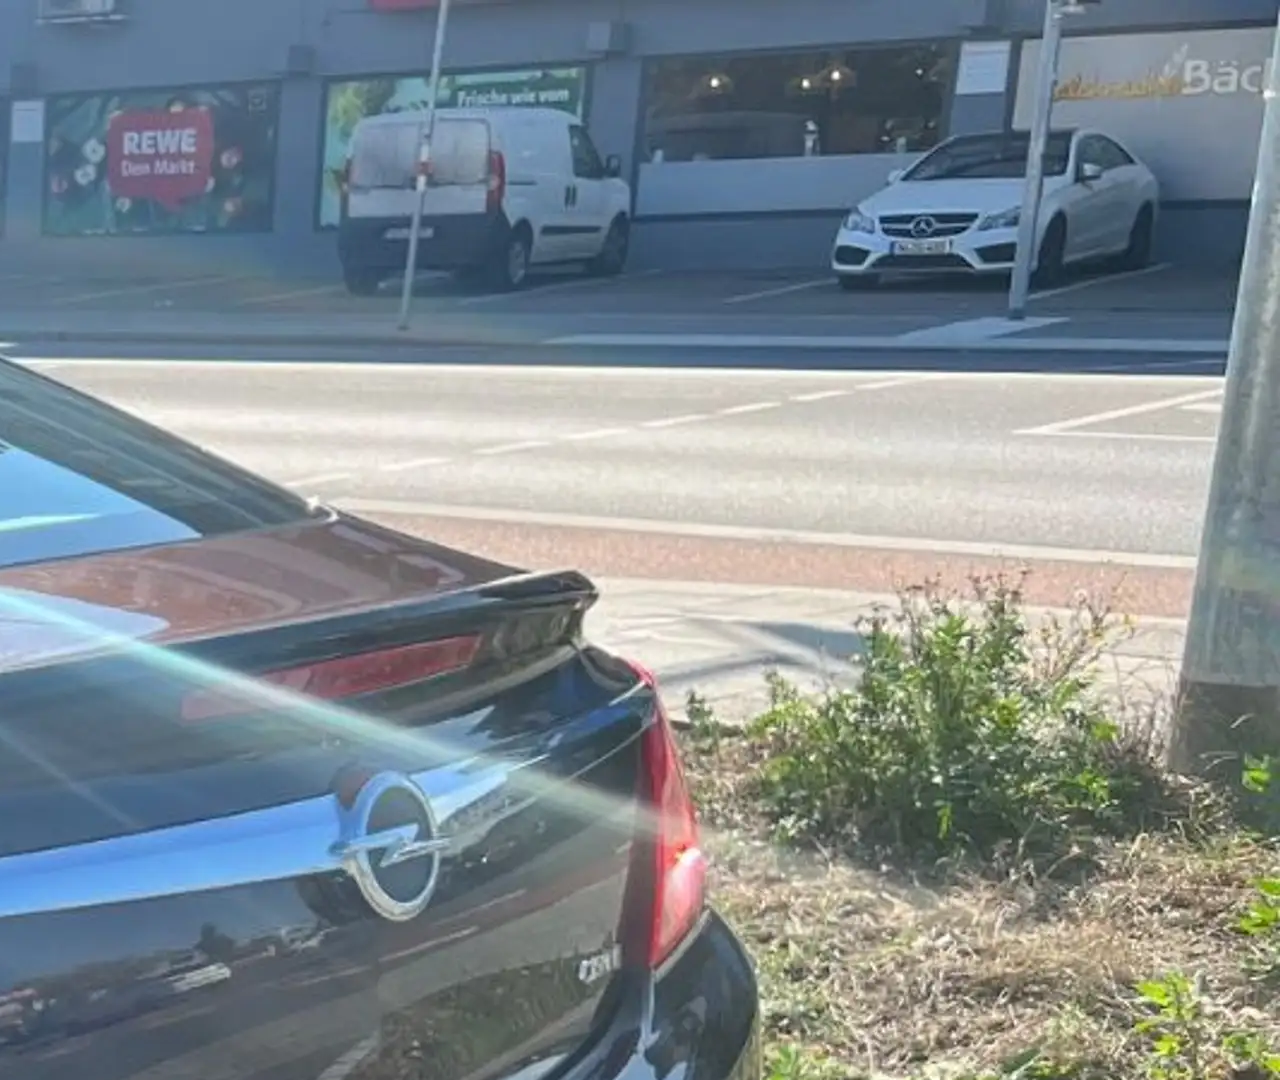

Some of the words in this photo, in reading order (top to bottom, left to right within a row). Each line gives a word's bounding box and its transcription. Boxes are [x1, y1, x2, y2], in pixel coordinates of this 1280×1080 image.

[457, 88, 507, 108] Frische
[123, 129, 197, 156] REWE
[154, 158, 195, 175] Markt
